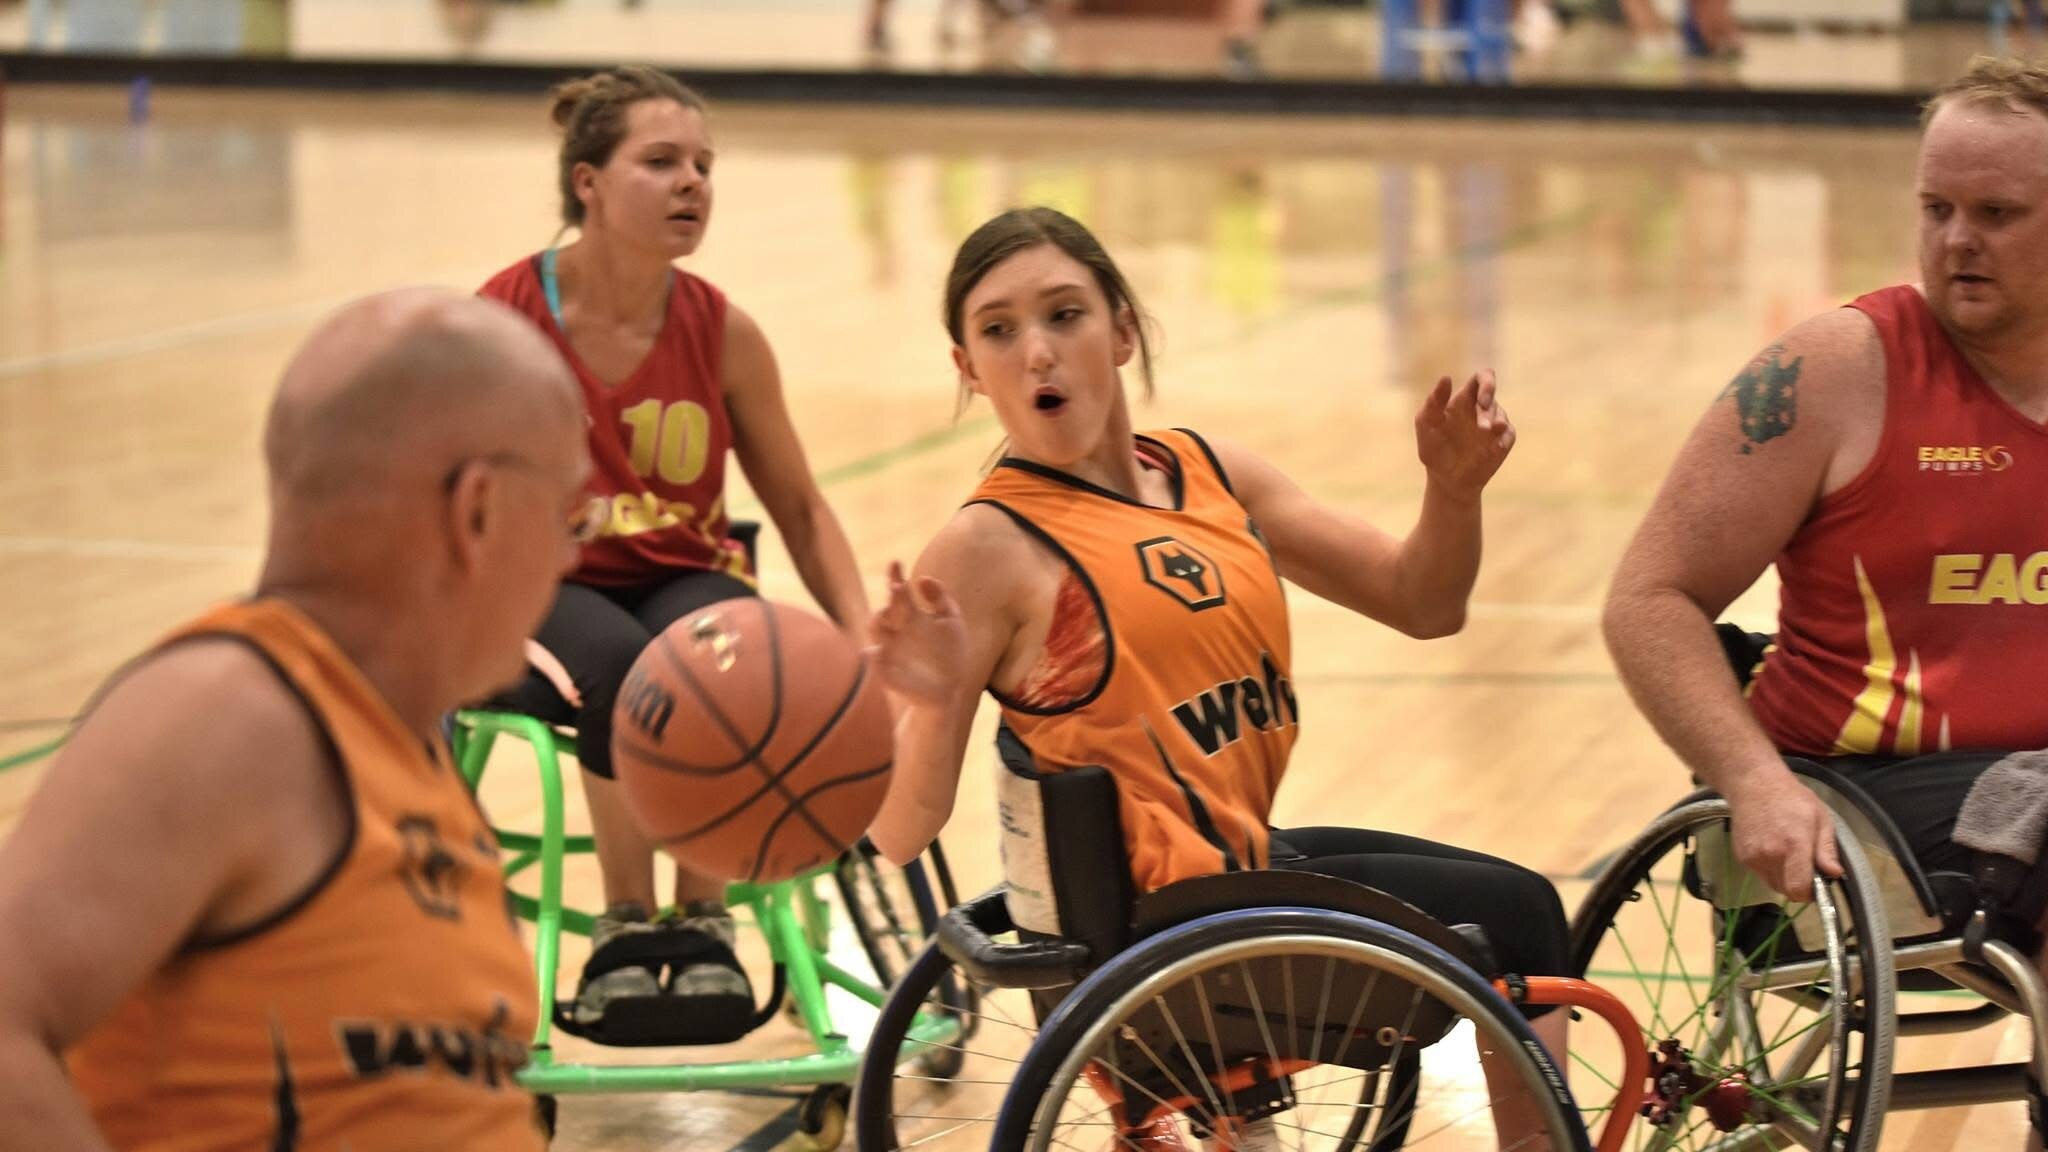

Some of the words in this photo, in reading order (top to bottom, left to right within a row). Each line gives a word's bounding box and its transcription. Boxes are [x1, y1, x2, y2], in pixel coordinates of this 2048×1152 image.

[620, 398, 709, 486] 10
[1918, 446, 1983, 462] EAGLE
[1918, 461, 1984, 472] PUMPS
